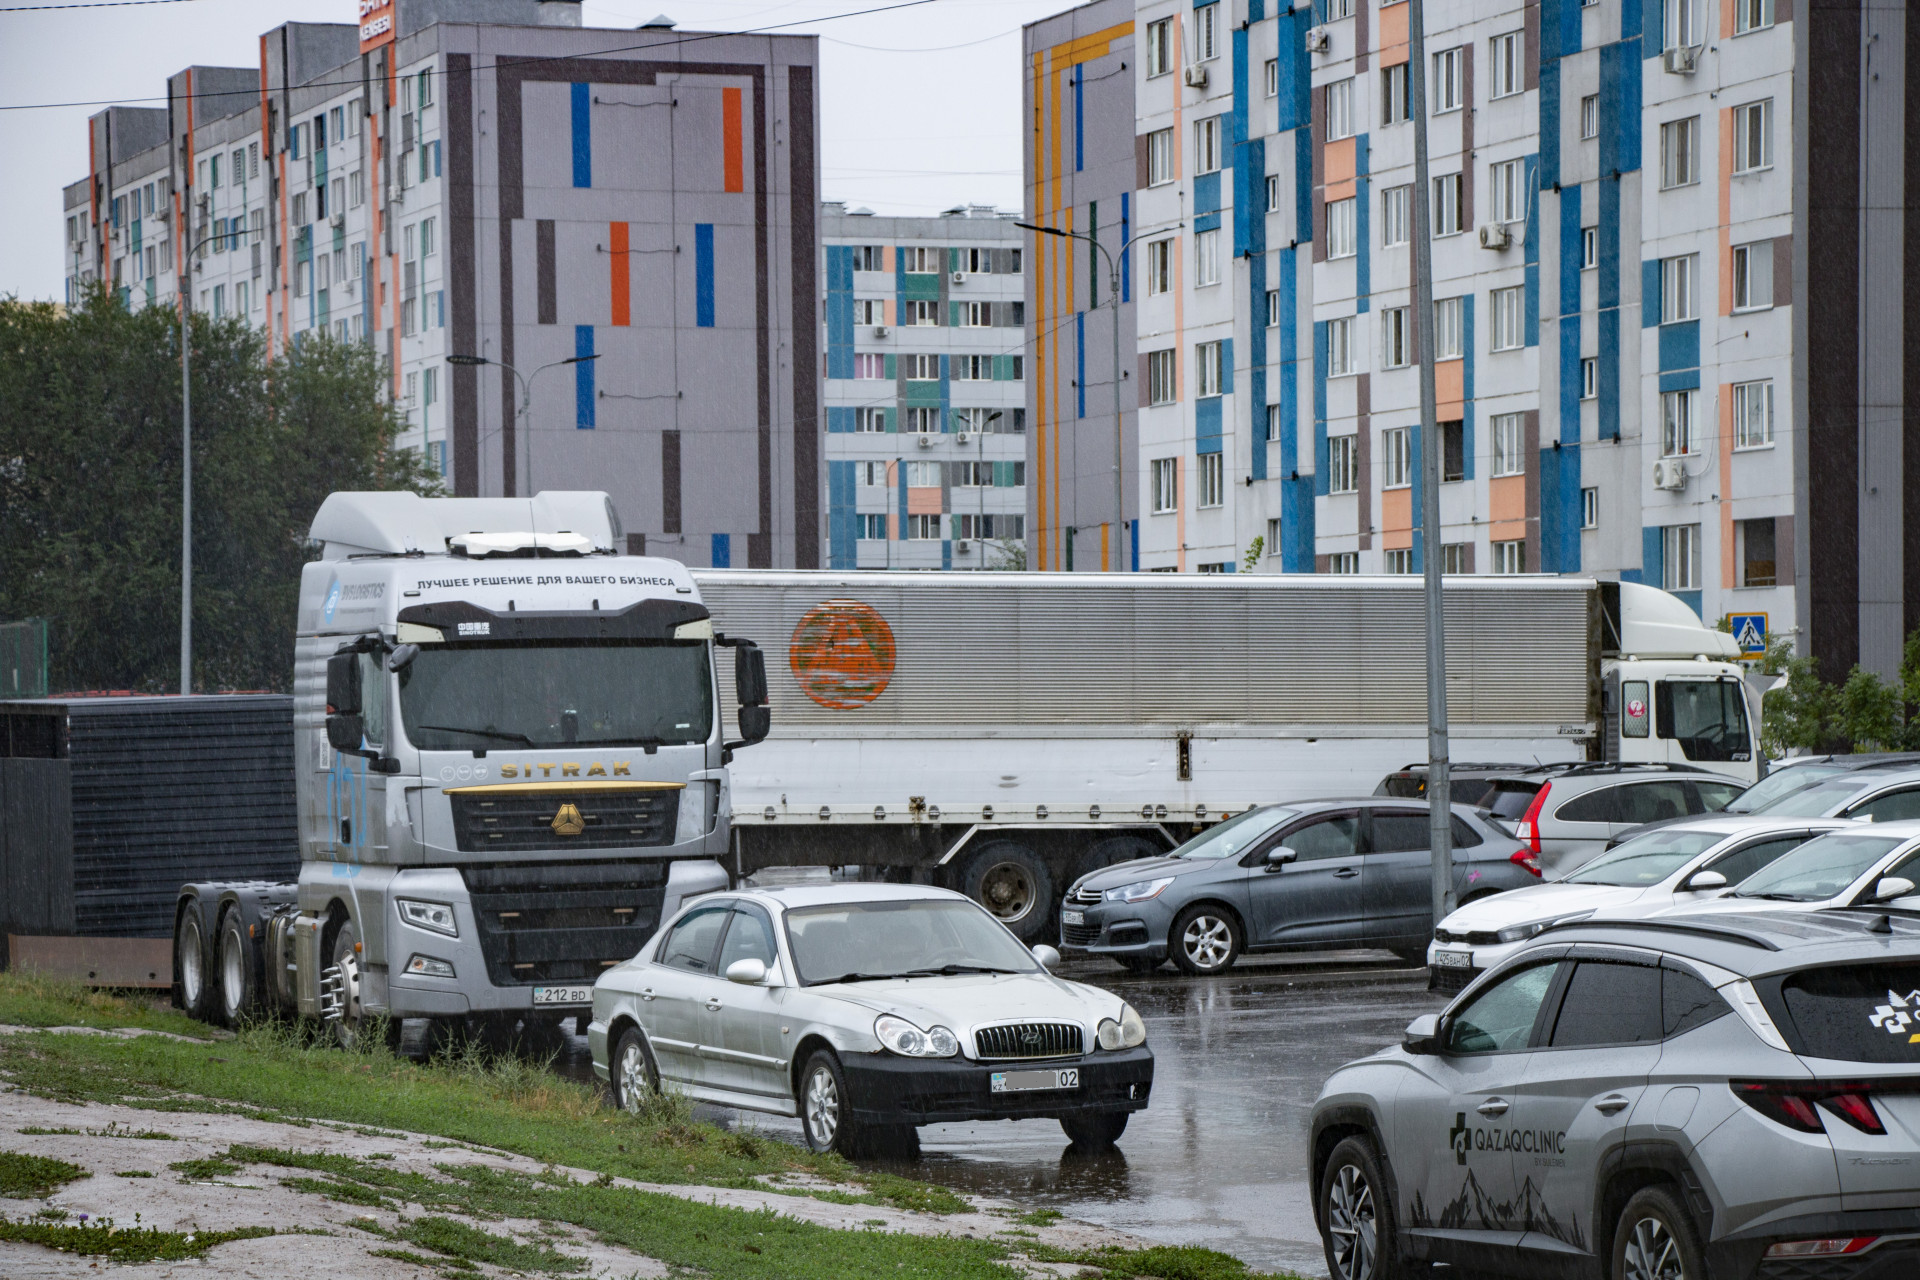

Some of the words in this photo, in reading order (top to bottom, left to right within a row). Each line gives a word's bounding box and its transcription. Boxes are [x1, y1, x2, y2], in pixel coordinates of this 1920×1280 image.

[418, 578, 469, 589] ЛУЧШЕЕ
[473, 576, 533, 586] РЕШЕНИЕ
[537, 576, 562, 585] ДЛЯ
[565, 576, 616, 585] ВАШЕГО
[620, 576, 675, 587] БИЗНЕСА
[501, 761, 631, 778] SITRAK
[545, 988, 567, 1001] 212
[571, 991, 586, 1001] BD
[1060, 1071, 1078, 1087] 02
[1475, 1128, 1566, 1154] QAZAQCLINIC
